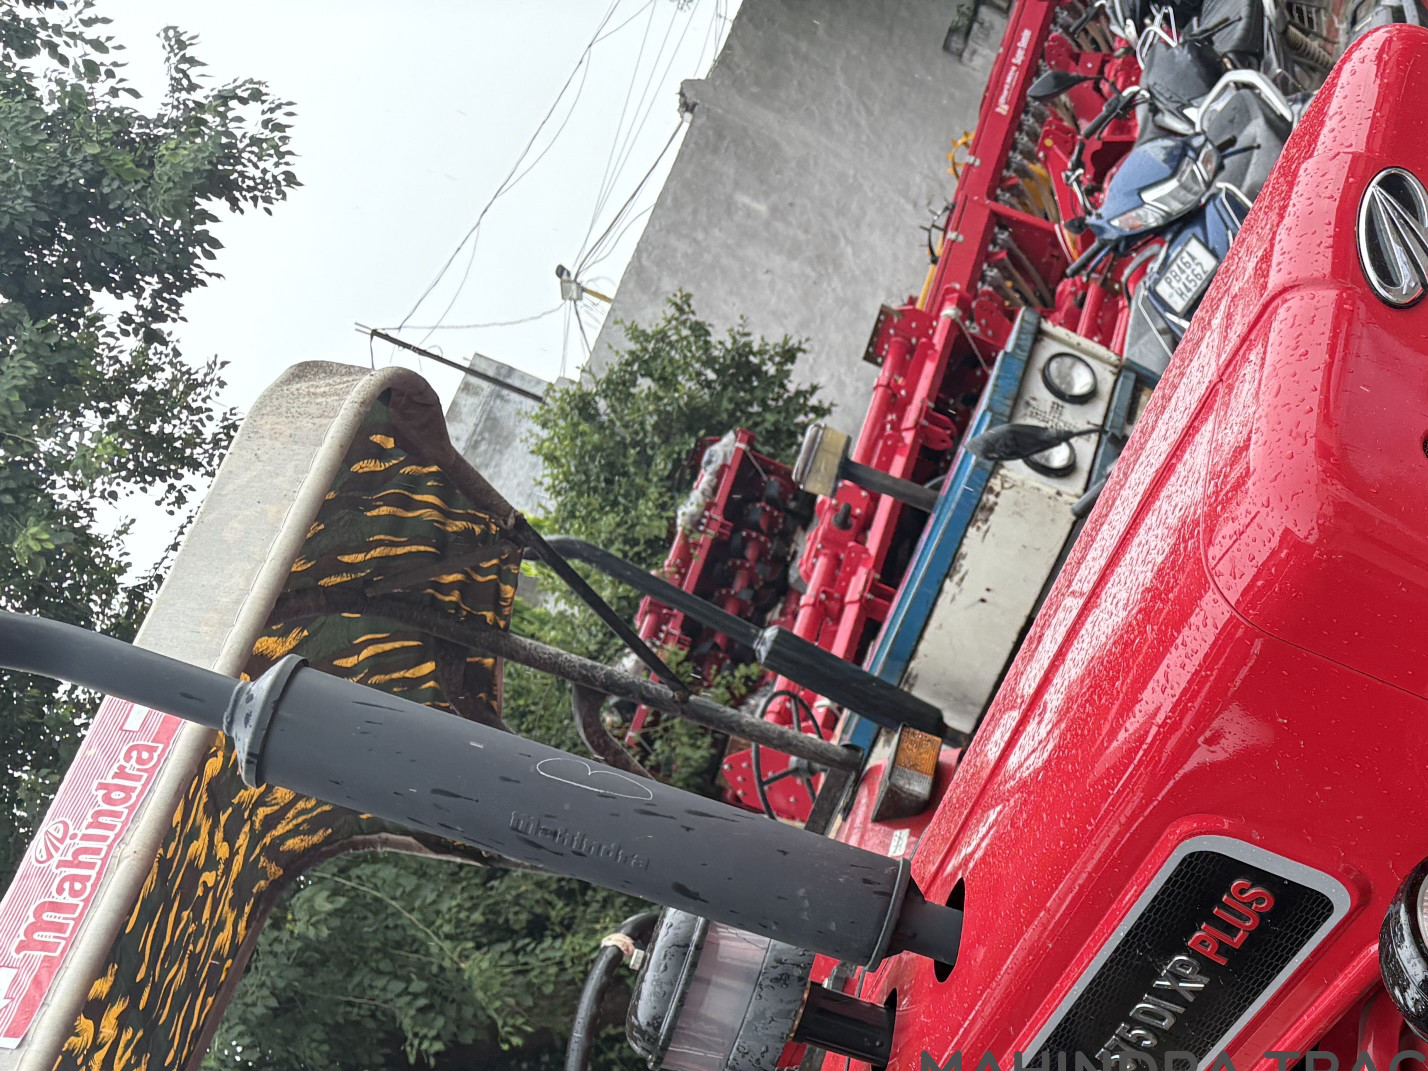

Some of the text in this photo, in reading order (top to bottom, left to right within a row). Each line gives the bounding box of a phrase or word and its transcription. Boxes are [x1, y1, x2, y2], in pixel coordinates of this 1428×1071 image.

[1187, 876, 1276, 965] PLUS
[1152, 953, 1211, 1002] XP
[1128, 992, 1187, 1029] DI
